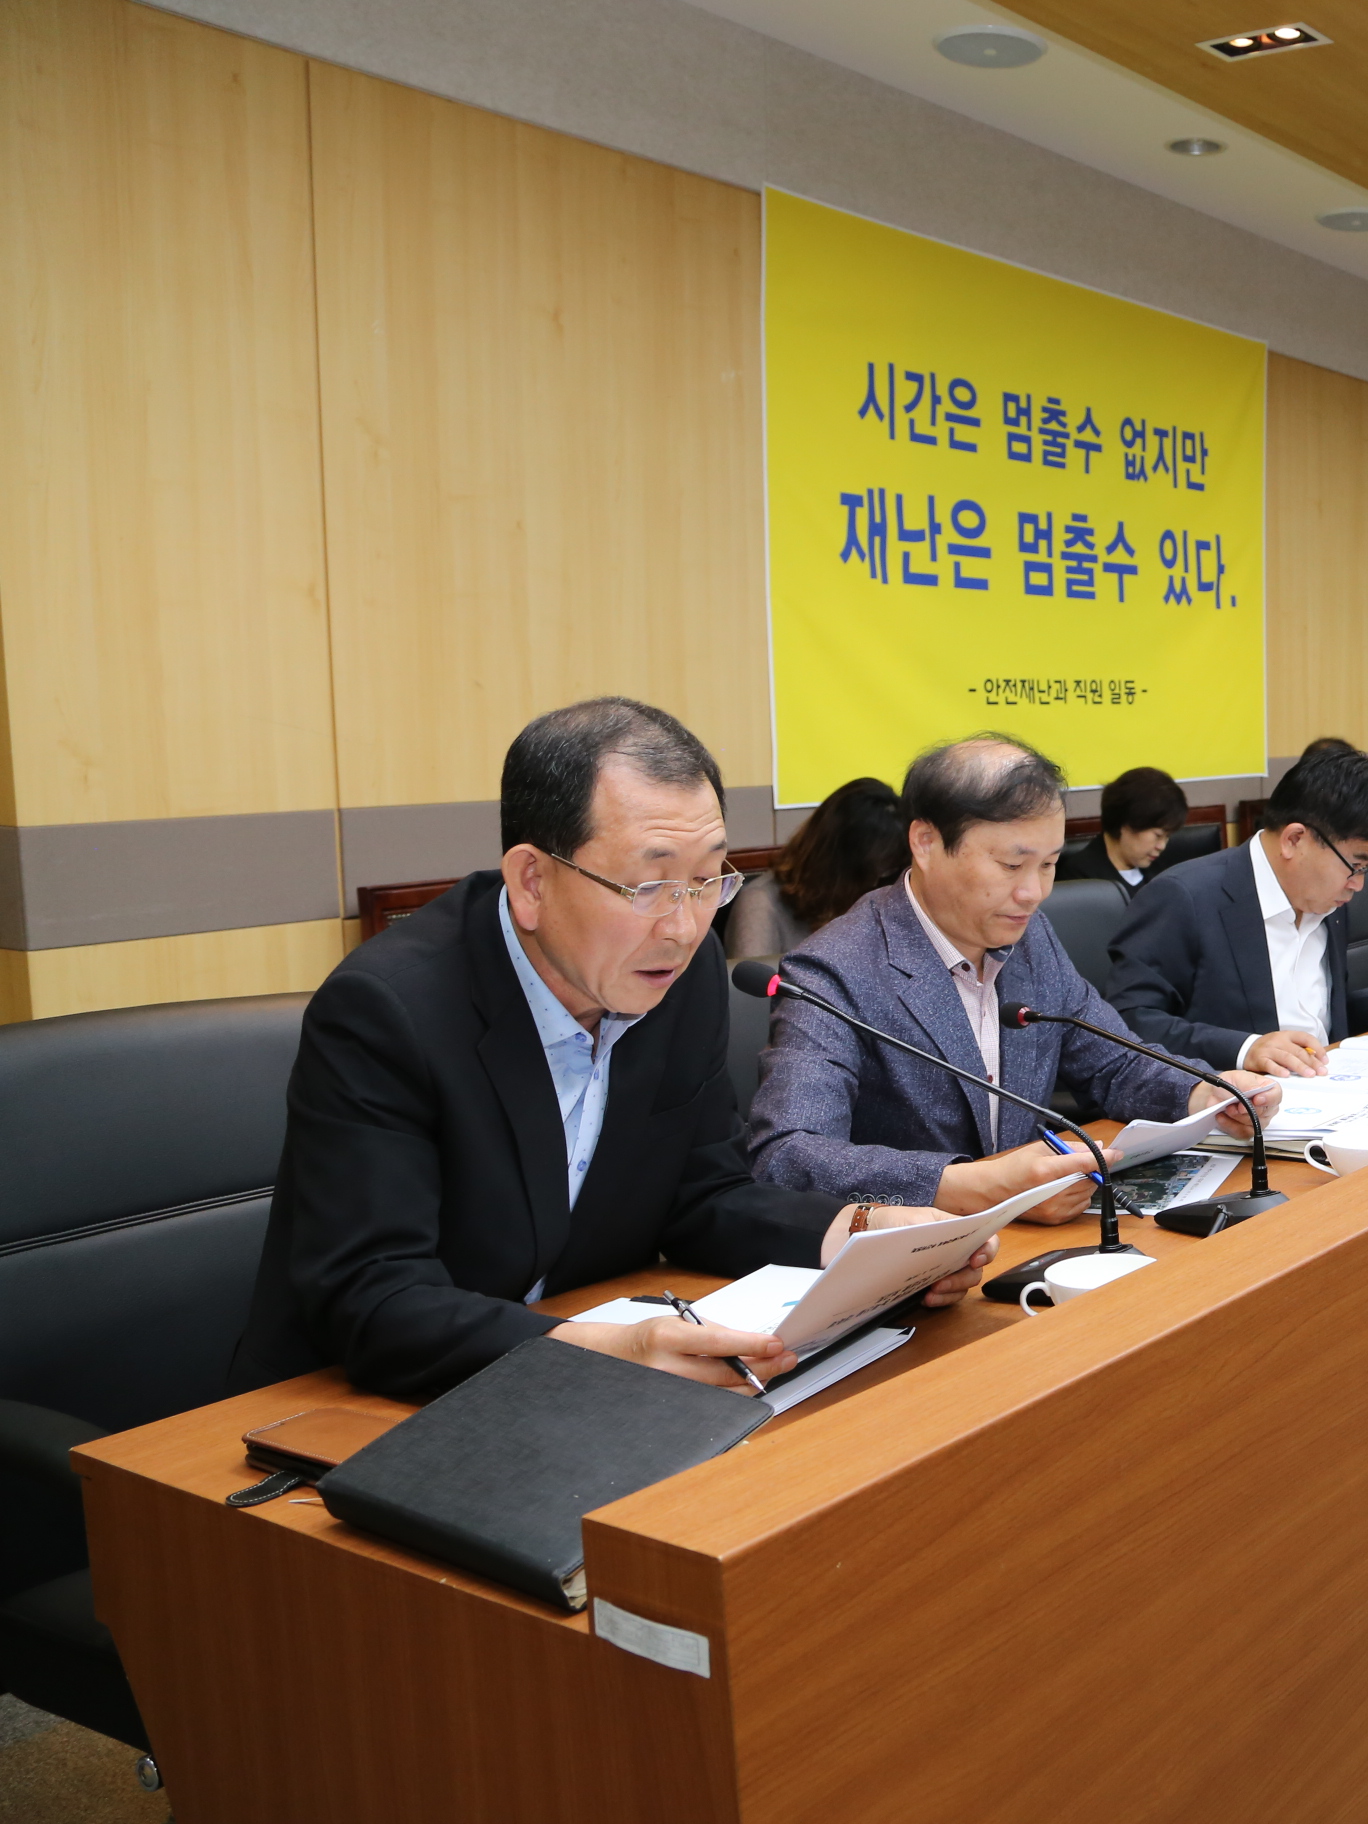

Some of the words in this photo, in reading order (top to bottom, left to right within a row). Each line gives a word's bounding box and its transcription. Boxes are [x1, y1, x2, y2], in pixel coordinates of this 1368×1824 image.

[858, 362, 982, 453] 시간은
[1002, 391, 1103, 475] 멈출수
[1120, 417, 1209, 492] 없지만
[838, 487, 993, 591] 재난은
[1017, 511, 1139, 603] 멈출수
[1159, 528, 1238, 609] 있다.
[984, 678, 1069, 705] 안전재난과
[1073, 679, 1103, 705] 직원
[1108, 679, 1136, 705] 일동
